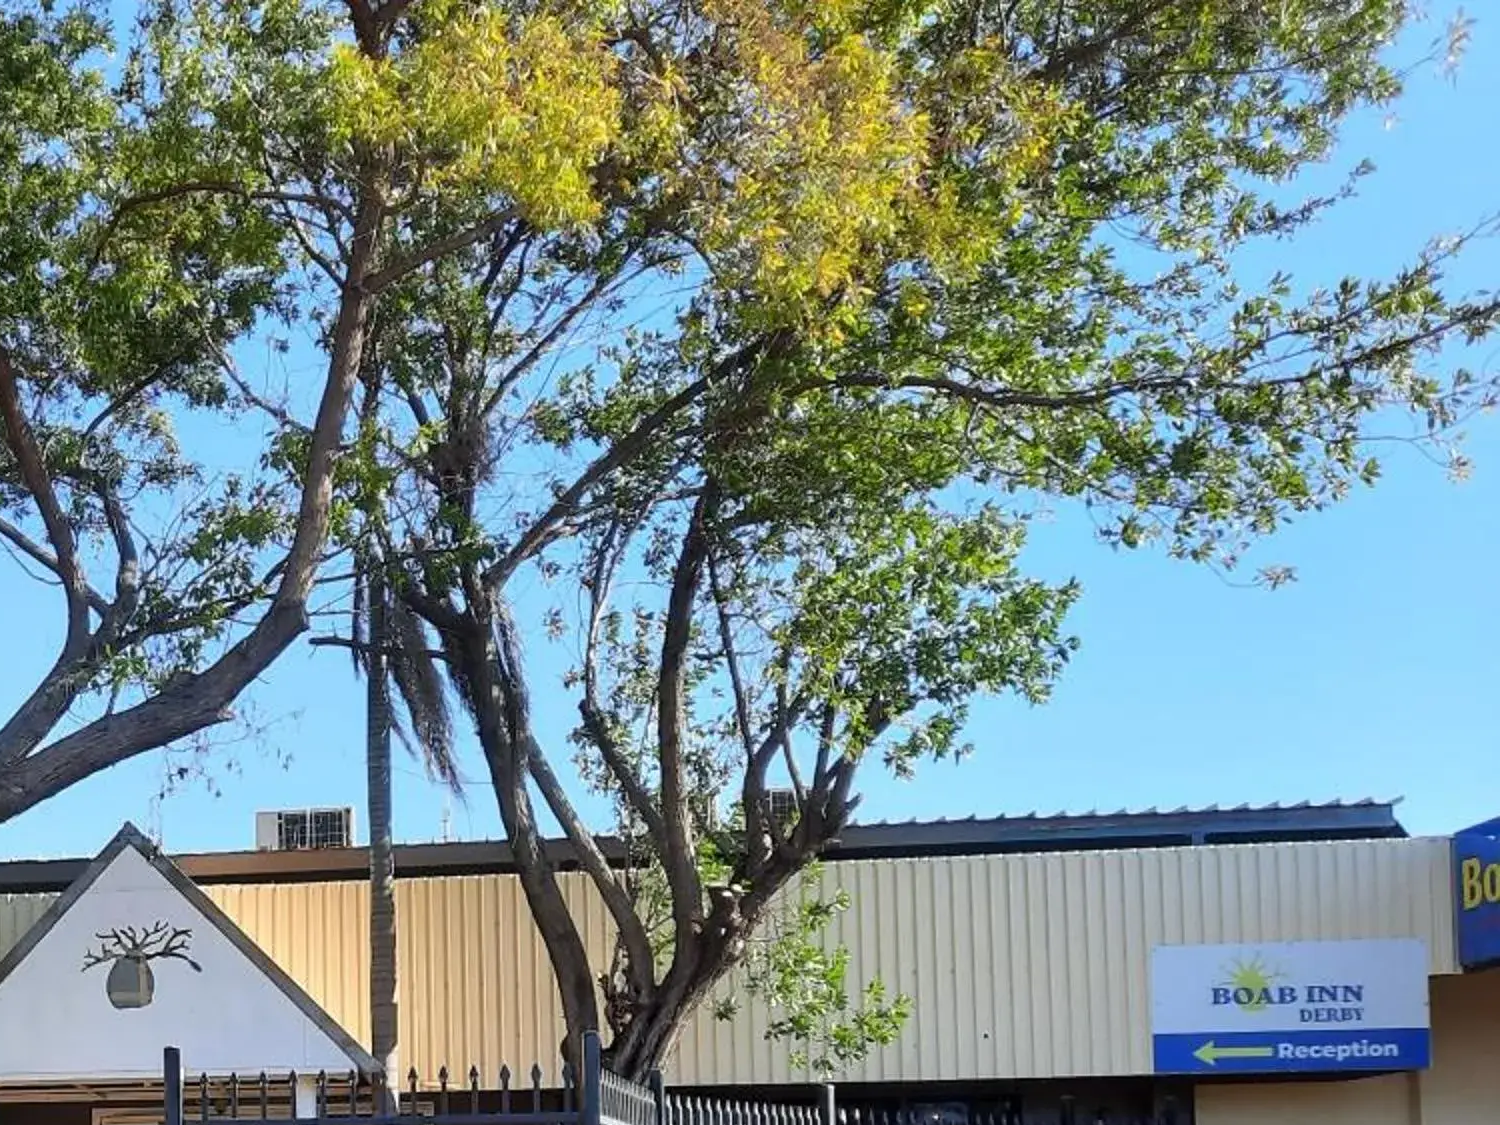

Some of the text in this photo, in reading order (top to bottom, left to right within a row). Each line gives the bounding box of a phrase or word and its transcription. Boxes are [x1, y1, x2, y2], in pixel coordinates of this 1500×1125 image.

[1211, 985, 1364, 1005] BOAB INN
[1300, 1007, 1365, 1023] DERBY
[1277, 1040, 1399, 1062] Reception
